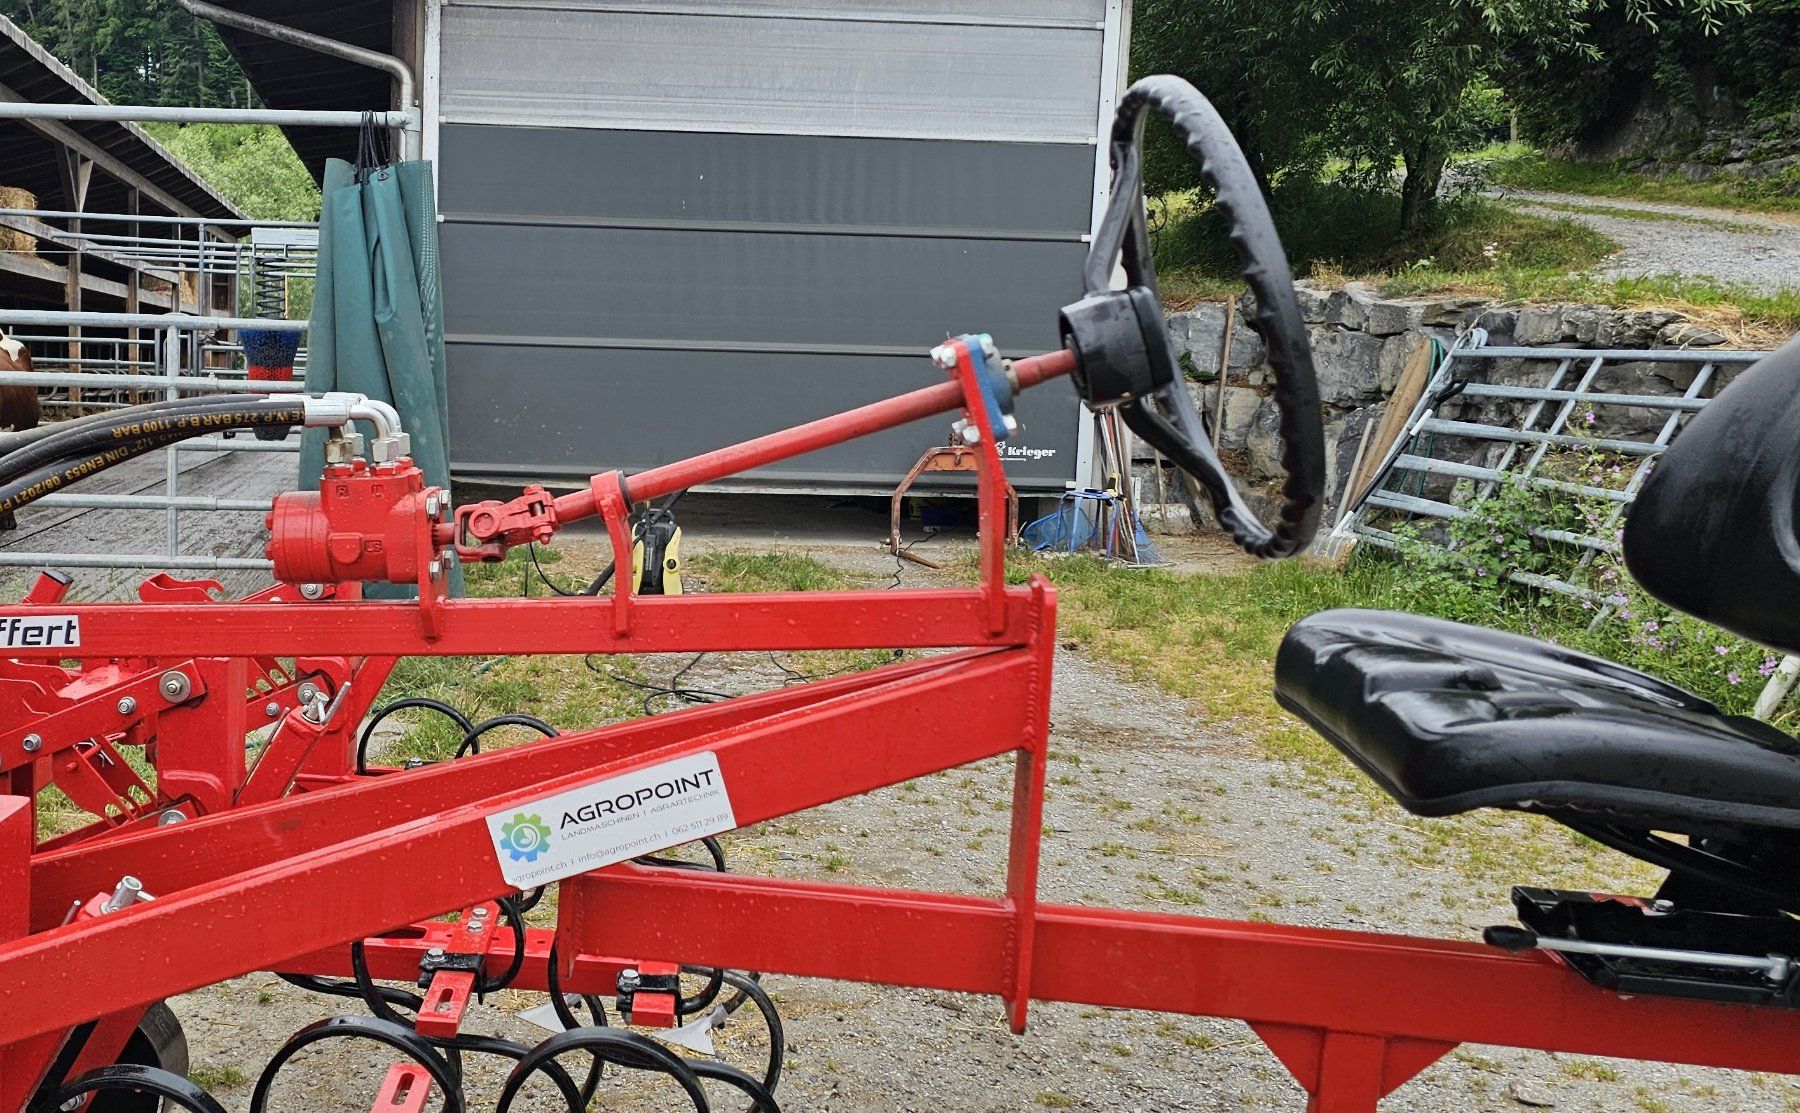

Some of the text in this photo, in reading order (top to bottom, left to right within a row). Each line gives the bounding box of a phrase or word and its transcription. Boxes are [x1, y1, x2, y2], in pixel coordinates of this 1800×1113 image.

[203, 413, 232, 426] BAR
[235, 411, 258, 423] 275
[112, 424, 140, 438] BAR
[143, 419, 172, 433] 1100
[105, 446, 129, 462] DIN
[1007, 446, 1056, 459] Krieger
[64, 456, 105, 480] EN853
[13, 475, 61, 504] 08/2021
[364, 540, 382, 552] LS
[560, 769, 713, 830] AGROPOINT
[561, 788, 720, 840] LANDMASCHINEN AGRARTECHNIK
[578, 832, 661, 863] info@agropoint.ch
[671, 824, 689, 836] 062
